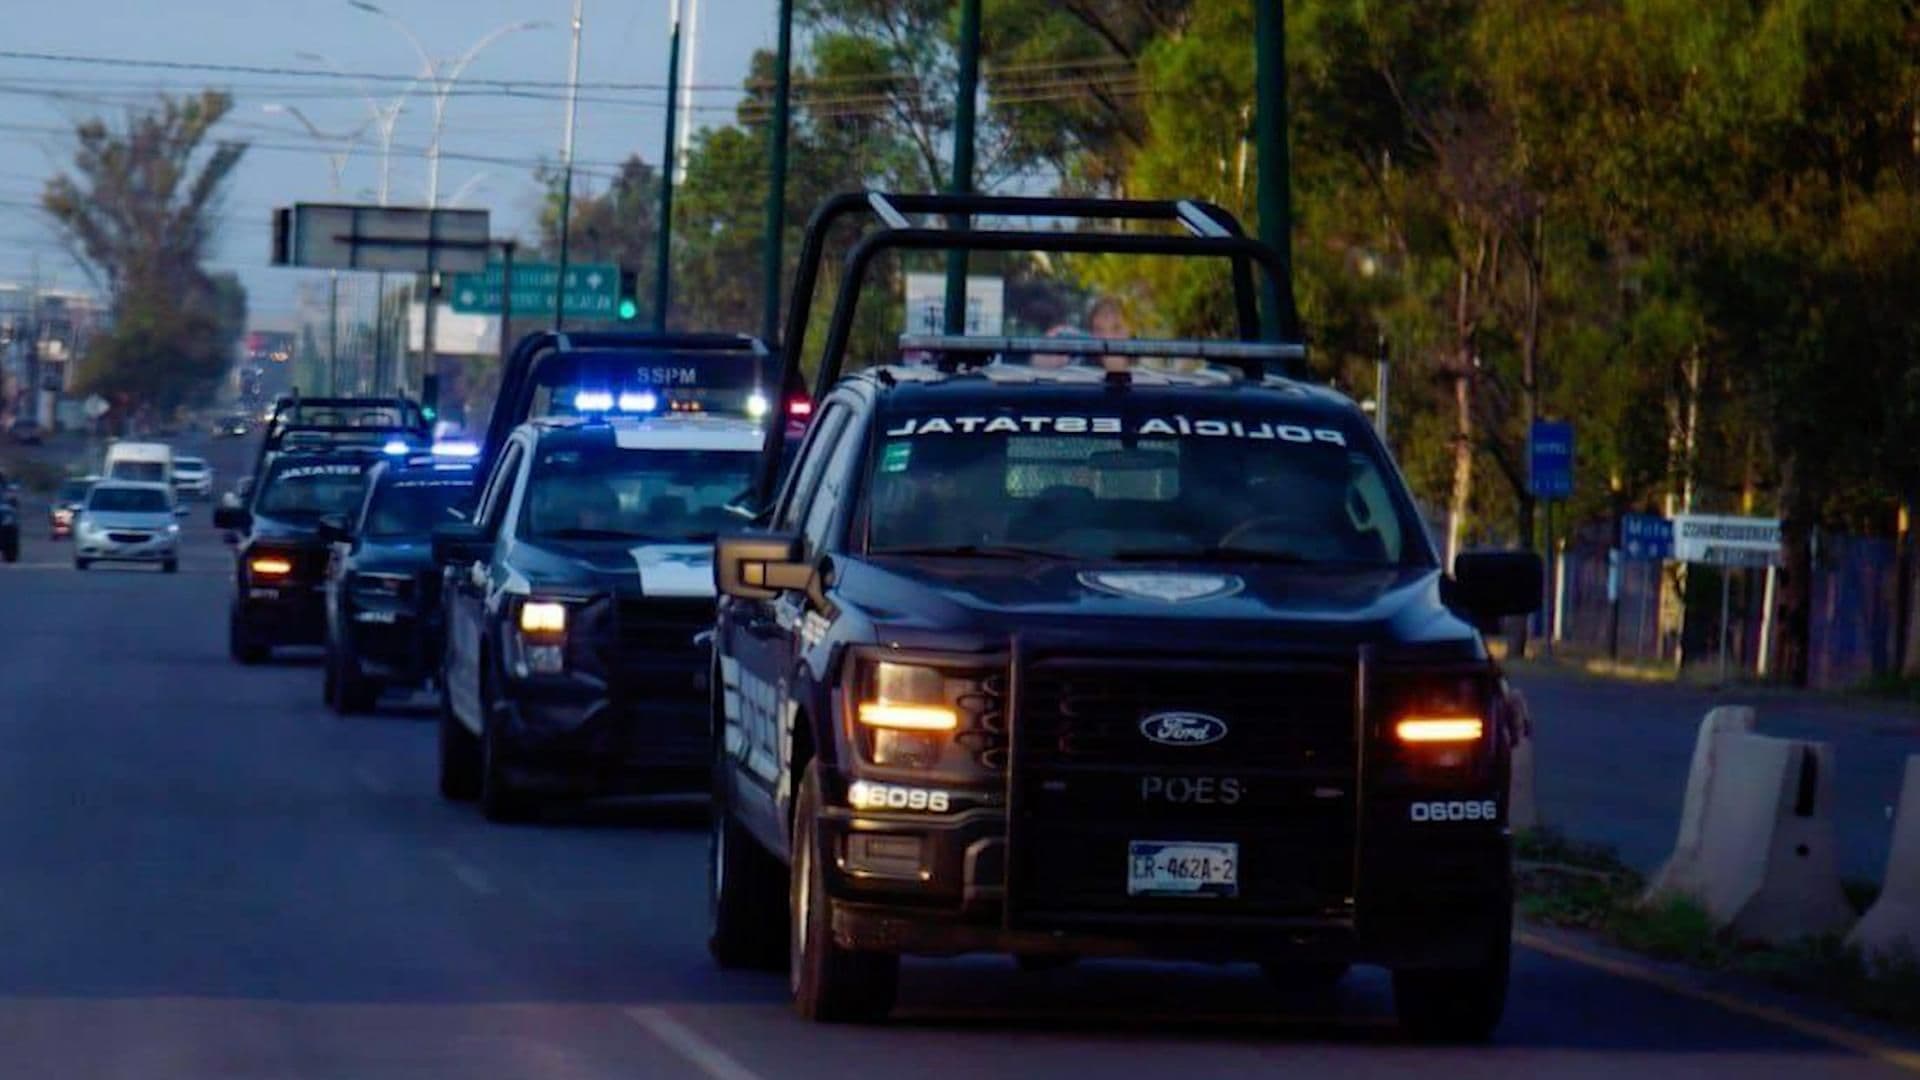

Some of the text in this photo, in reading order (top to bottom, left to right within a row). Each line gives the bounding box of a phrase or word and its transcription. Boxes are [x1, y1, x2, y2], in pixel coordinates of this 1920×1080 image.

[637, 367, 697, 385] SSPM
[1157, 717, 1211, 740] Ford
[1142, 776, 1240, 804] POES
[1411, 801, 1497, 820] 06096
